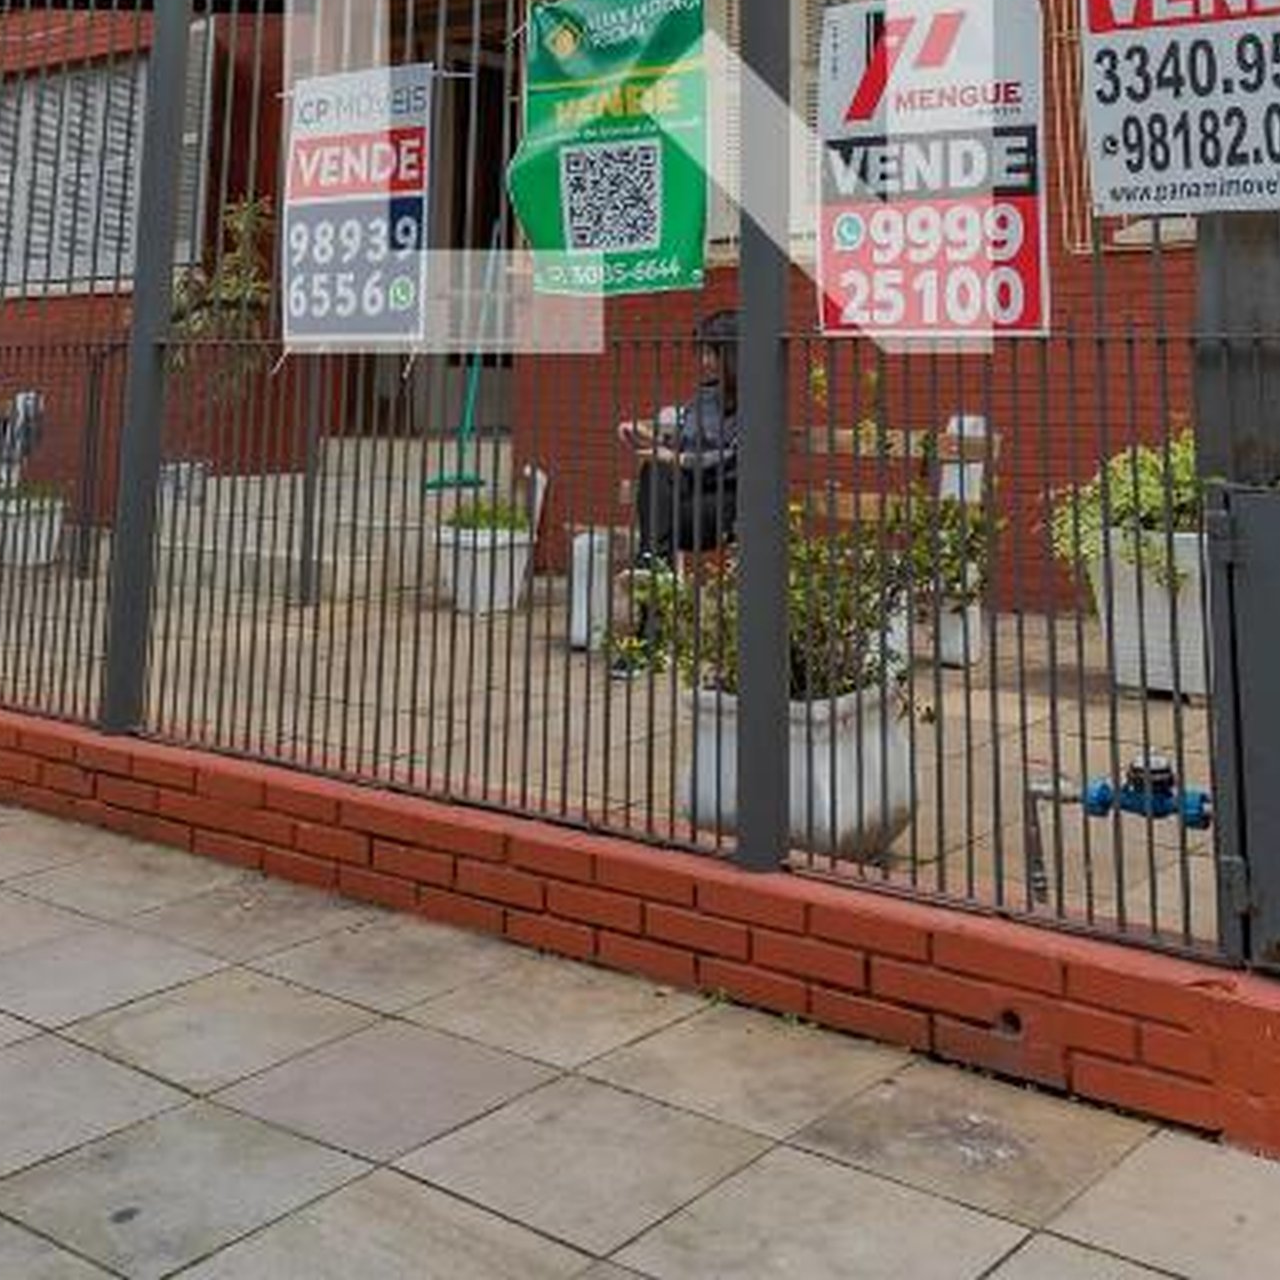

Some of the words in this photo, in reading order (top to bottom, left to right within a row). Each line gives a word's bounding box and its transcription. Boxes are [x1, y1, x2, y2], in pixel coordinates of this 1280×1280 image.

[895, 81, 1023, 111] MENGUE
[298, 138, 420, 188] VENDE
[827, 135, 1029, 195] VENDE
[289, 216, 418, 268] 98939
[870, 203, 1023, 265] 9999
[288, 272, 385, 318] 6556
[840, 267, 1024, 327] 25100
